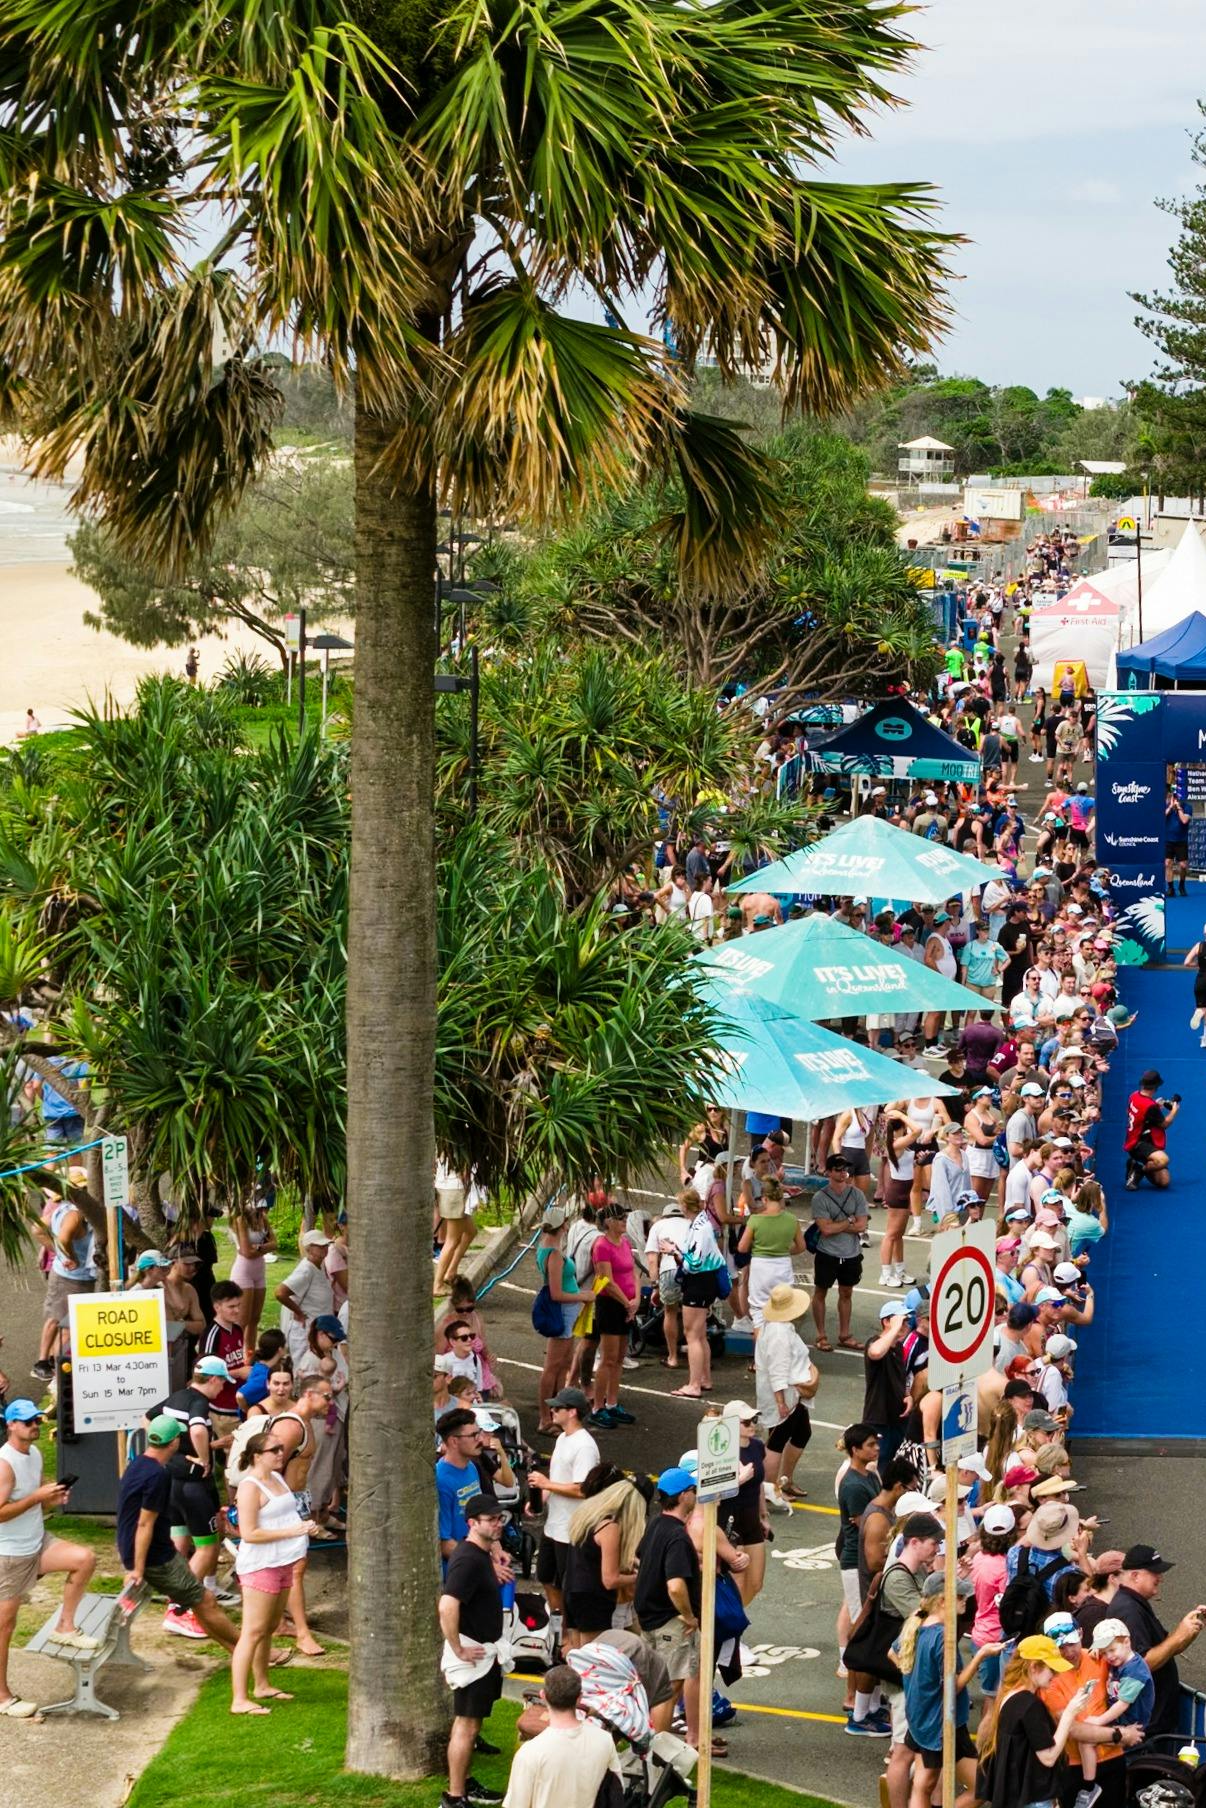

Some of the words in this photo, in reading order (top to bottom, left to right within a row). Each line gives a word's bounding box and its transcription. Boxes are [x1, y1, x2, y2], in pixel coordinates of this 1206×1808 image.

[1070, 617, 1088, 625] First
[1091, 617, 1106, 625] Aid
[838, 853, 886, 870] LIVE!
[1110, 873, 1155, 887] Queensland
[813, 966, 853, 982] IT'S
[852, 964, 907, 981] LIVE!
[836, 978, 908, 995] Queensland
[105, 1142, 125, 1160] 2P
[944, 1276, 985, 1334] 20
[97, 1309, 138, 1325] ROAD
[85, 1331, 153, 1348] CLOSURE
[78, 1364, 89, 1373] Fri
[93, 1363, 101, 1372] 13
[106, 1363, 120, 1371] Mar
[82, 1390, 99, 1399] Sun
[104, 1389, 113, 1397] 15
[118, 1388, 133, 1396] Mar
[138, 1386, 157, 1397] 7pm
